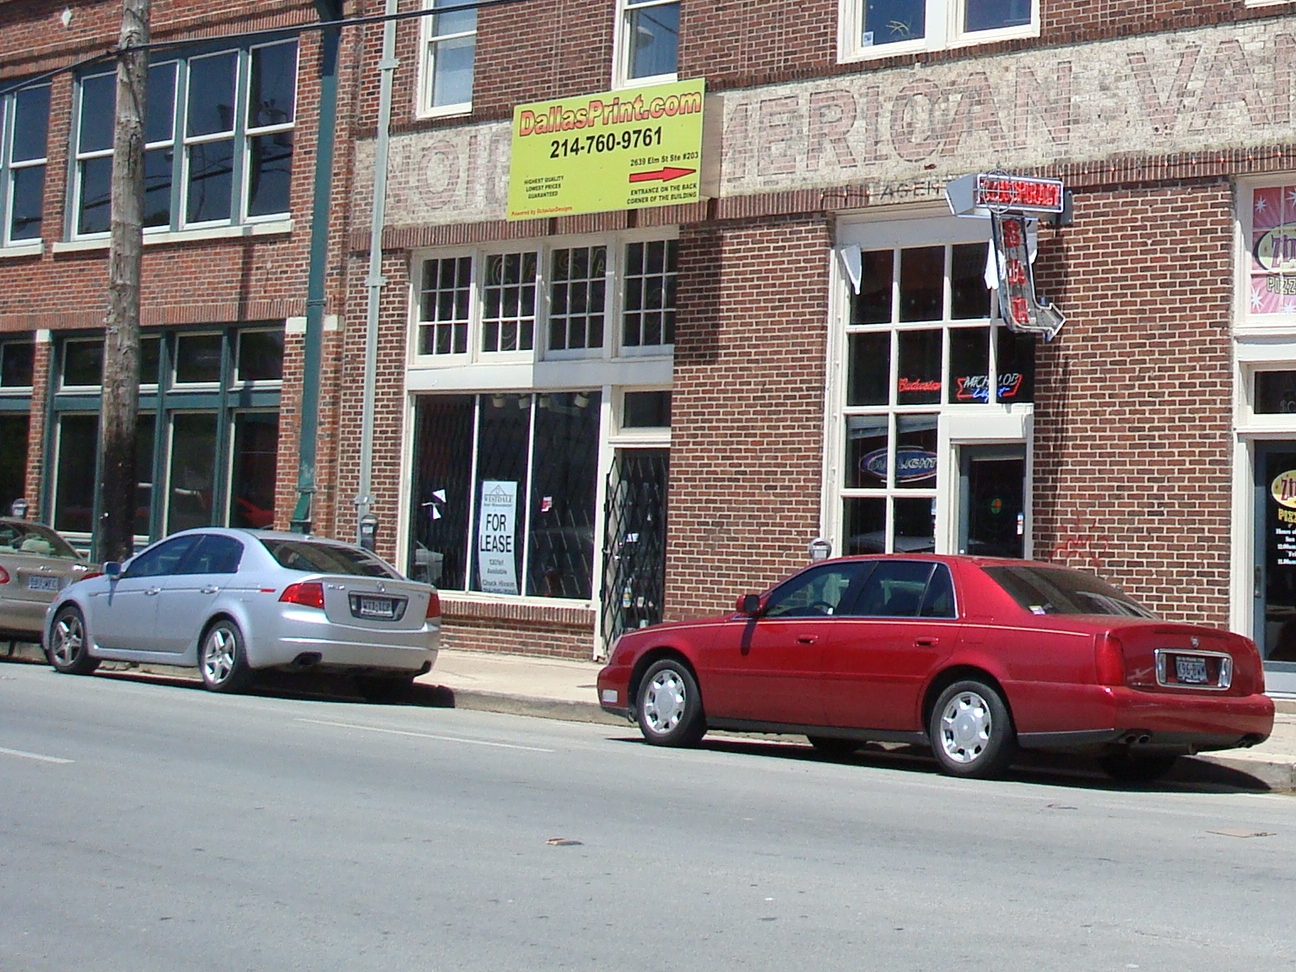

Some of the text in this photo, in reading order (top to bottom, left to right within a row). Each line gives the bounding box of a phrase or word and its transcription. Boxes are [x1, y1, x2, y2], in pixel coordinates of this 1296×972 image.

[519, 91, 701, 137] DallasPrint.com
[550, 126, 662, 158] 214-760-9761
[683, 151, 698, 160] #203
[544, 175, 564, 183] QUALITY
[627, 196, 648, 204] CORNER
[670, 192, 696, 200] BUILDING
[630, 187, 659, 196] ENTRANCE
[486, 514, 506, 532] FOR
[480, 535, 512, 553] LEASE
